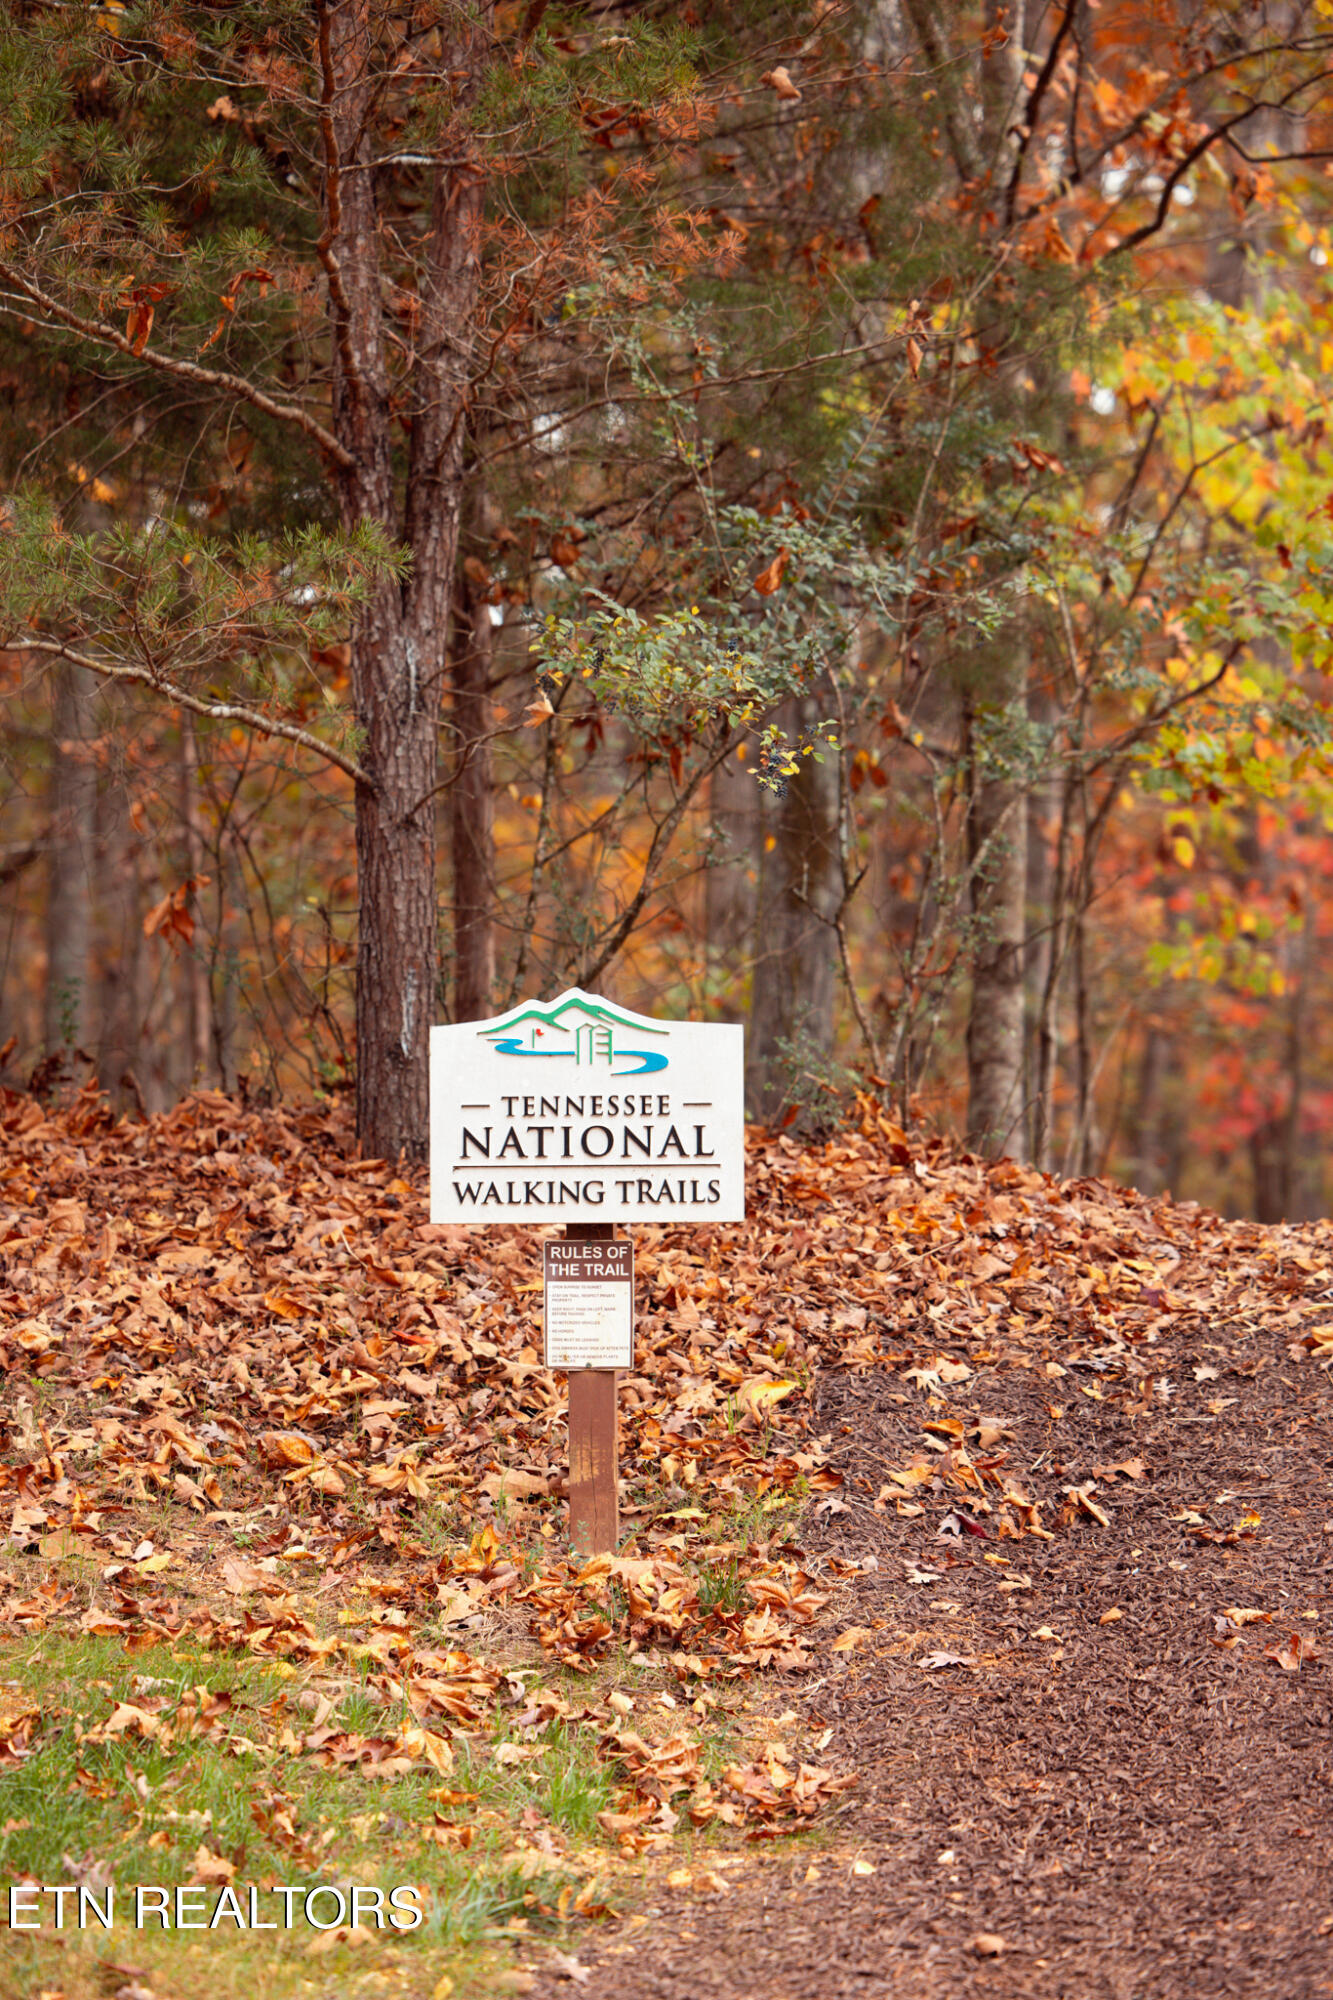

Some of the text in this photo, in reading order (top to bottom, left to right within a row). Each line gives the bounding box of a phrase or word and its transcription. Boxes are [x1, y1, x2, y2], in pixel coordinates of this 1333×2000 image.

[501, 1095, 671, 1118] TENNESSEE
[460, 1124, 715, 1159] NATIONAL
[453, 1179, 721, 1205] WALKING TRAILS
[550, 1246, 628, 1259] RULES OF
[549, 1263, 629, 1276] THE TRAIL
